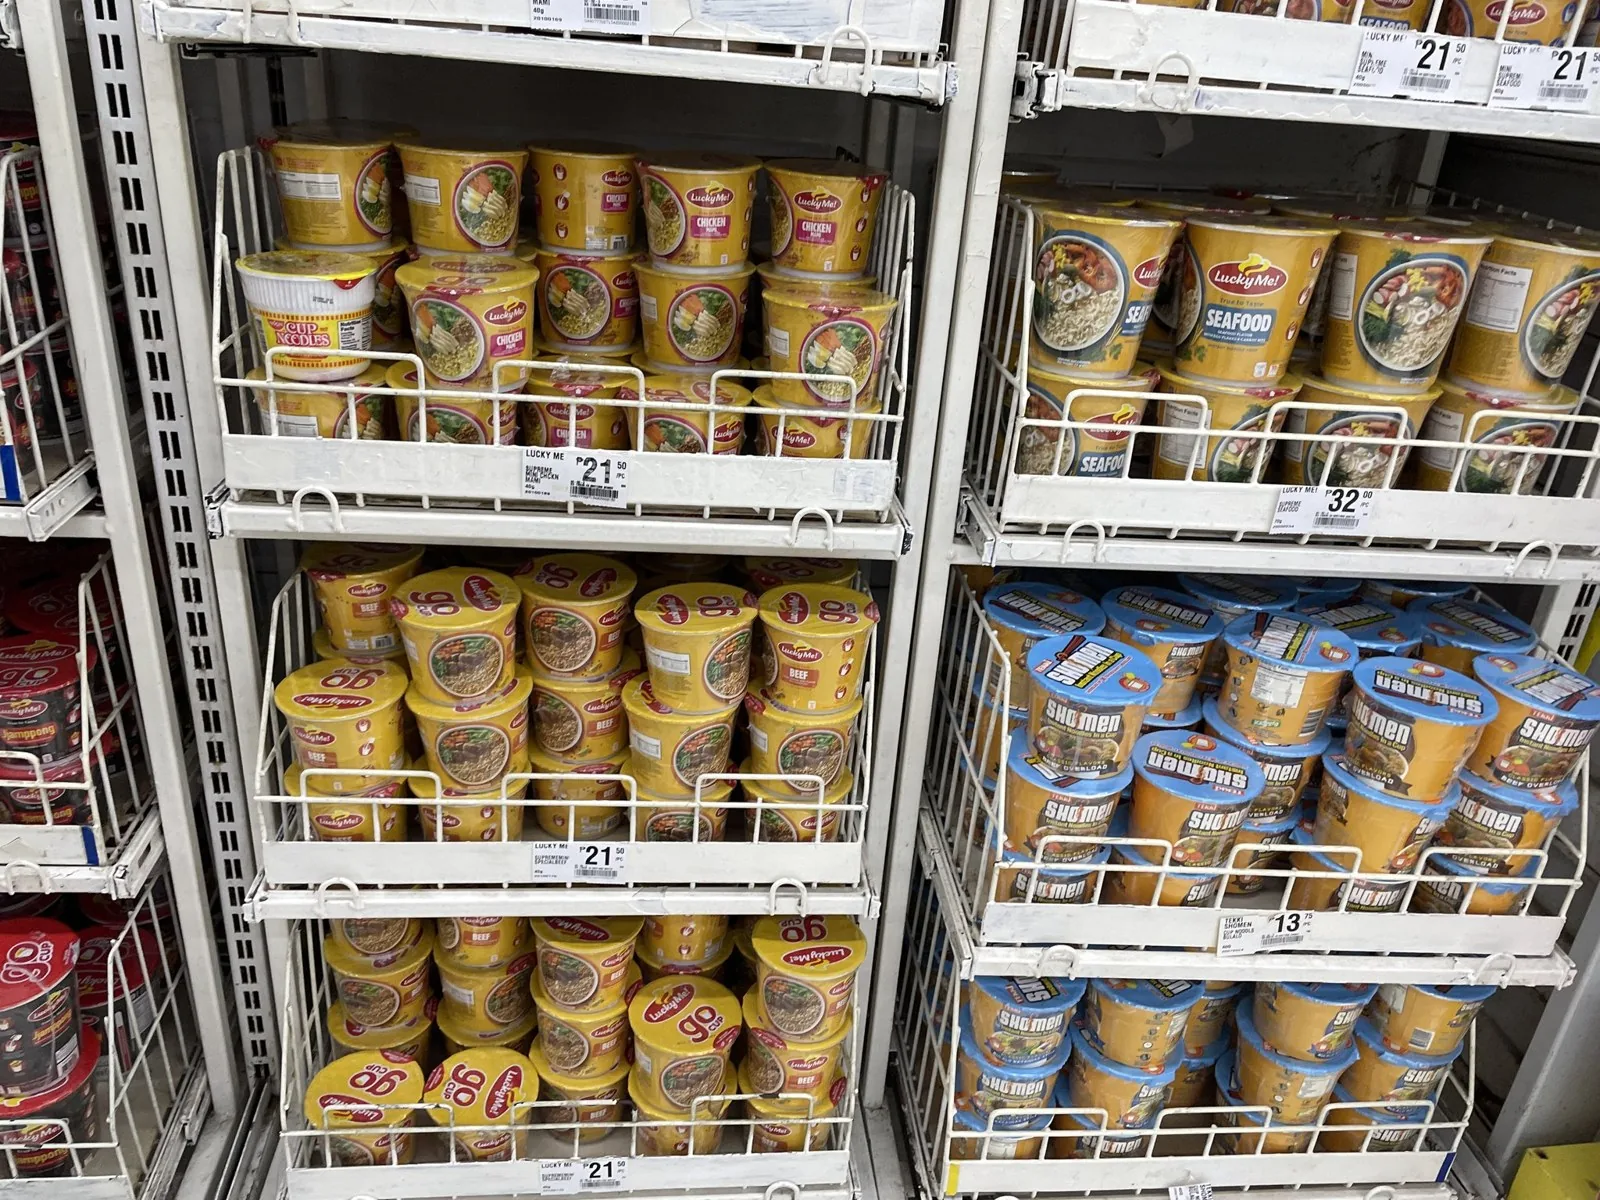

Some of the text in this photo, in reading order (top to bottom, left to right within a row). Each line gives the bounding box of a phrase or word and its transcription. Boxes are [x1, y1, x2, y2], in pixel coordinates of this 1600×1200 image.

[1490, 3, 1541, 20] LukyMe!
[1456, 43, 1466, 53] 50
[696, 217, 726, 229] CHICKEN
[801, 221, 832, 234] CHICKEN
[1125, 304, 1152, 324] SEAF
[1206, 309, 1272, 332] SEAFOOD
[285, 322, 317, 334] CUP
[276, 332, 331, 347] NOODLES
[496, 331, 523, 346] CHICKEN
[550, 405, 591, 417] LuckMe!
[526, 449, 564, 461] LUCKY ME
[617, 461, 627, 470] 50
[1081, 456, 1124, 473] SEAFOO
[1362, 491, 1373, 499] 00
[360, 602, 379, 612] BEEF
[789, 669, 809, 680] BEEF
[596, 718, 614, 730] BEEF
[308, 751, 326, 762] BEEF
[1063, 764, 1108, 772] OVERLOAD
[1264, 762, 1303, 781] men
[616, 847, 625, 855] 50
[1224, 922, 1252, 930] SHOMEN
[472, 932, 490, 941] BEEF
[40, 942, 53, 961] CUP
[790, 948, 845, 963] LuckyMe!
[611, 967, 625, 981] BEEF
[648, 986, 691, 1021] LuckyMe!
[678, 1005, 717, 1043] go
[708, 1016, 724, 1032] CUP
[366, 1065, 388, 1075] CUP
[797, 1076, 815, 1085] BEEF
[443, 1082, 456, 1100] CUP
